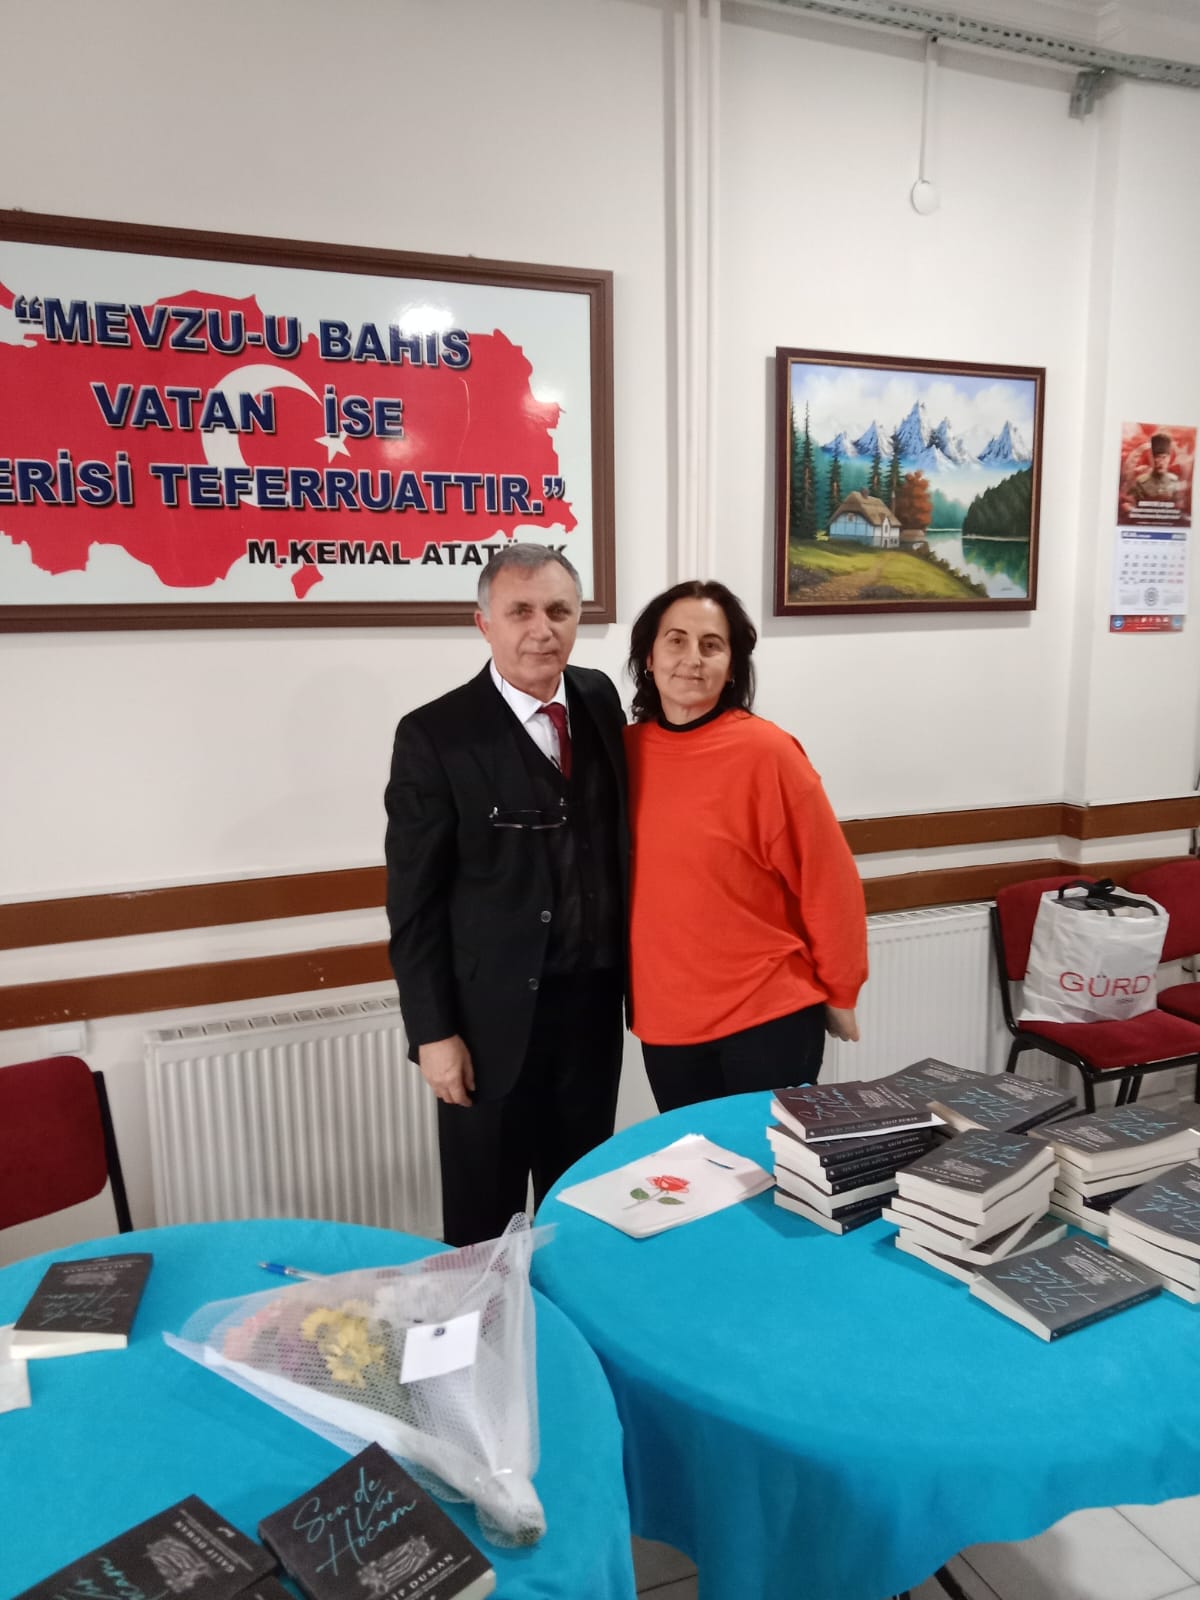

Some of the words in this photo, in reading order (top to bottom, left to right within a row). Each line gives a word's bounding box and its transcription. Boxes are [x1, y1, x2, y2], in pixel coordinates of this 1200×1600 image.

[15, 295, 302, 357] “MEVZU-U
[90, 382, 276, 433] VATAN
[324, 384, 404, 438] İSE
[150, 463, 566, 513] TEFERRUATTIR.”
[248, 541, 410, 565] M.KEMAL
[421, 539, 567, 565] ATAT
[1059, 971, 1157, 998] GÜRD
[293, 1496, 351, 1543] Sen
[354, 1466, 381, 1503] de
[174, 1520, 207, 1549] DUMAN
[315, 1499, 417, 1577] Hocam
[409, 1553, 454, 1589] DUMAN
